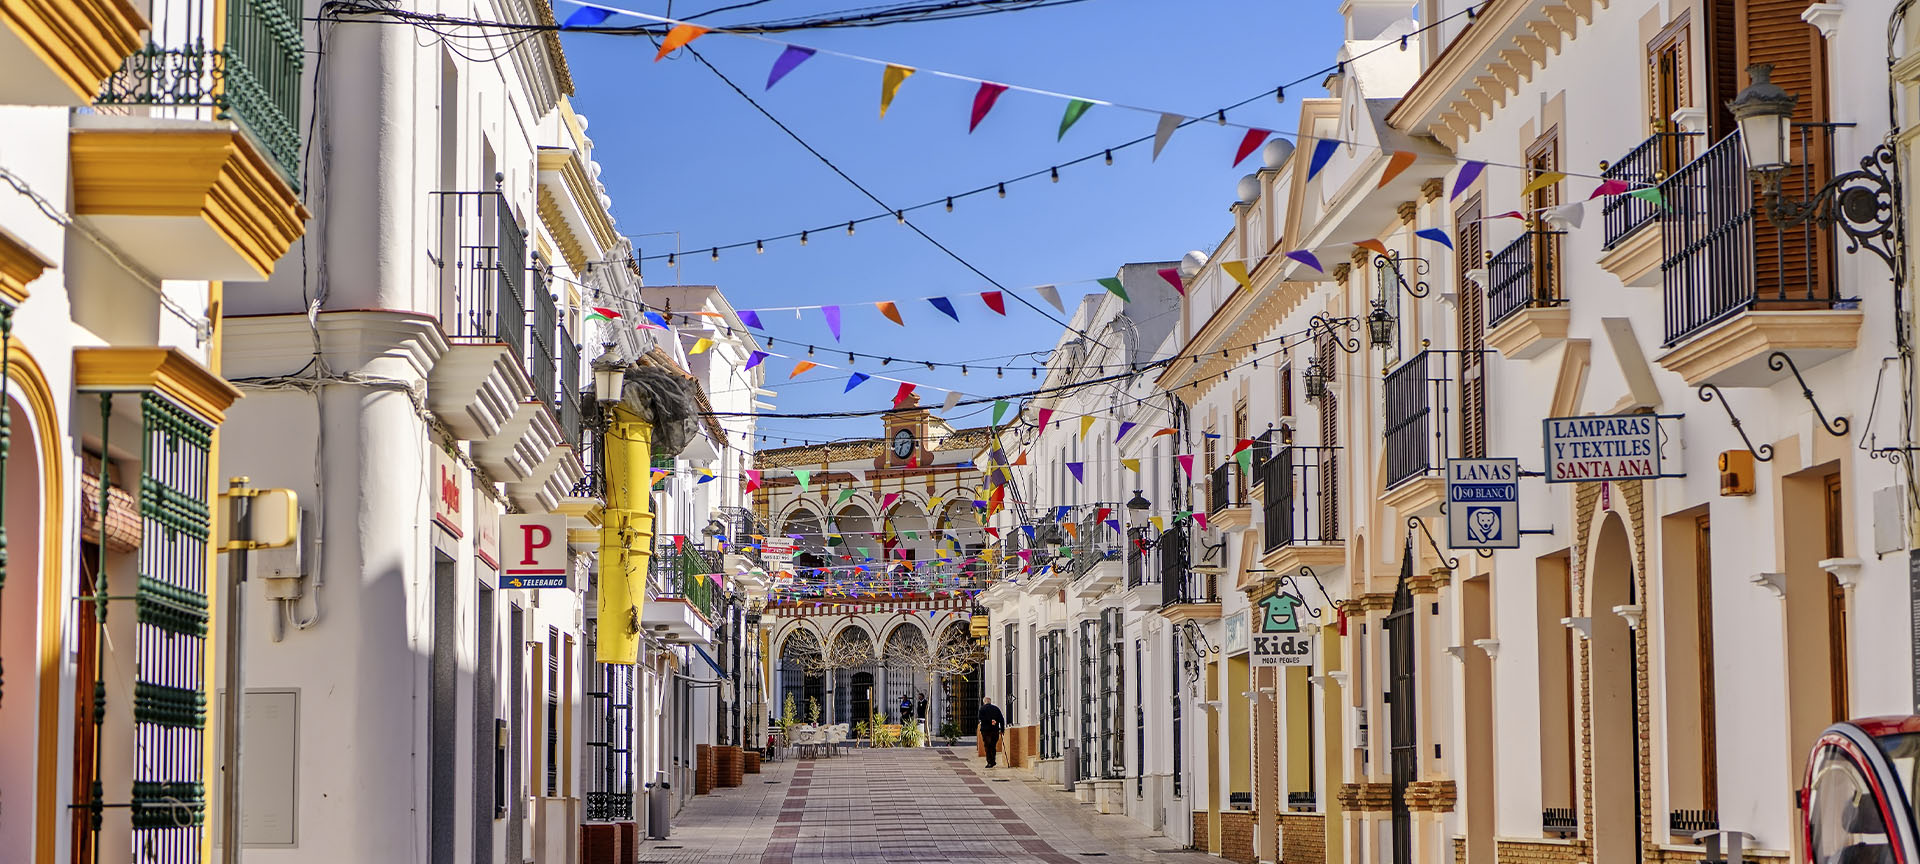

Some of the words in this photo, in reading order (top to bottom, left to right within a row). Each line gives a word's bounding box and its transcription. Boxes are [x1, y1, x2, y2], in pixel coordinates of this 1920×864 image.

[1554, 418, 1651, 438] LAMPARAS
[1555, 443, 1565, 459] Y
[1569, 439, 1651, 459] TEXTILES
[1456, 464, 1511, 480] LANAS
[1556, 461, 1613, 479] SANTA
[1617, 459, 1653, 477] ANA
[1453, 485, 1474, 500] OSO
[1475, 485, 1514, 500] BLANCO
[519, 524, 552, 565] P
[1253, 635, 1309, 655] Kids
